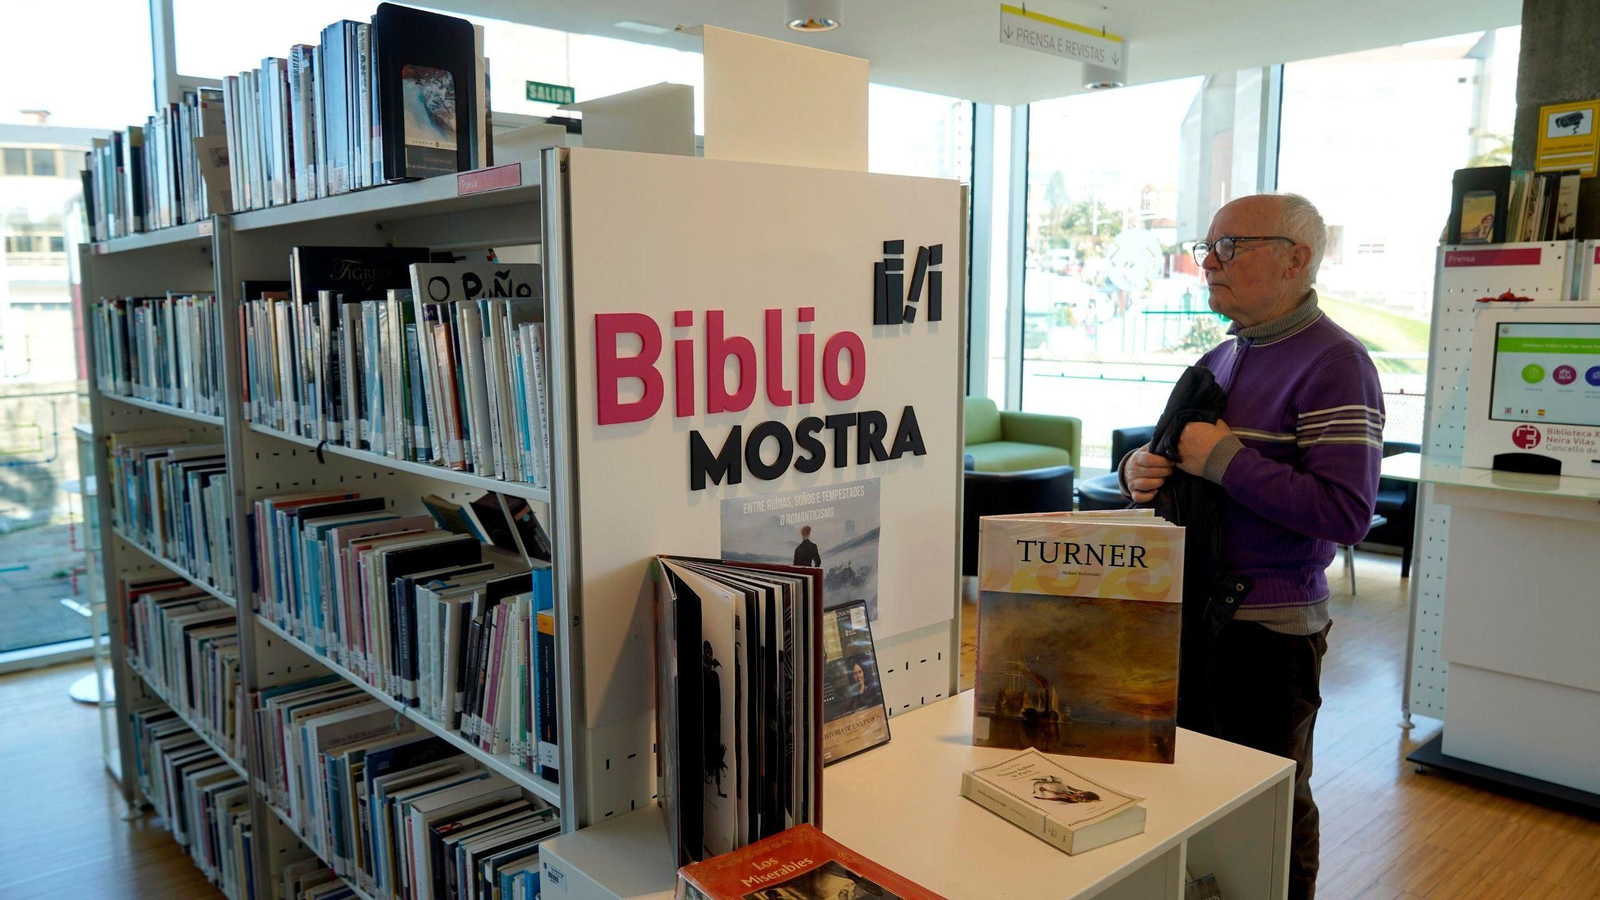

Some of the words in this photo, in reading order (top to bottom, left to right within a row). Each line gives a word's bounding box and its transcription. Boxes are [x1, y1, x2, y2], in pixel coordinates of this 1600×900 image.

[1016, 28, 1055, 49] PRENSA
[1057, 38, 1064, 52] E
[1065, 40, 1105, 62] REVISTAS
[528, 84, 572, 104] SALIDA
[428, 275, 450, 301] O
[595, 306, 867, 425] Biblio
[1546, 436, 1571, 444] Neira
[1574, 438, 1596, 446] Vilas
[1547, 428, 1593, 437] Biblioteca
[690, 405, 927, 490] MOSTRA
[1546, 444, 1585, 454] Concello
[743, 500, 765, 515] ENTRE
[766, 495, 792, 512] RUÍNAS,
[794, 491, 815, 507] SOÑOS
[816, 491, 821, 503] E
[821, 485, 865, 502] TEMPESTADES
[780, 513, 785, 526] O
[786, 506, 835, 525] ROMANTICISMO
[1016, 539, 1149, 568] TURNER
[823, 729, 844, 740] ISTORIA
[740, 856, 813, 887] Miserables
[751, 857, 779, 871] Los
